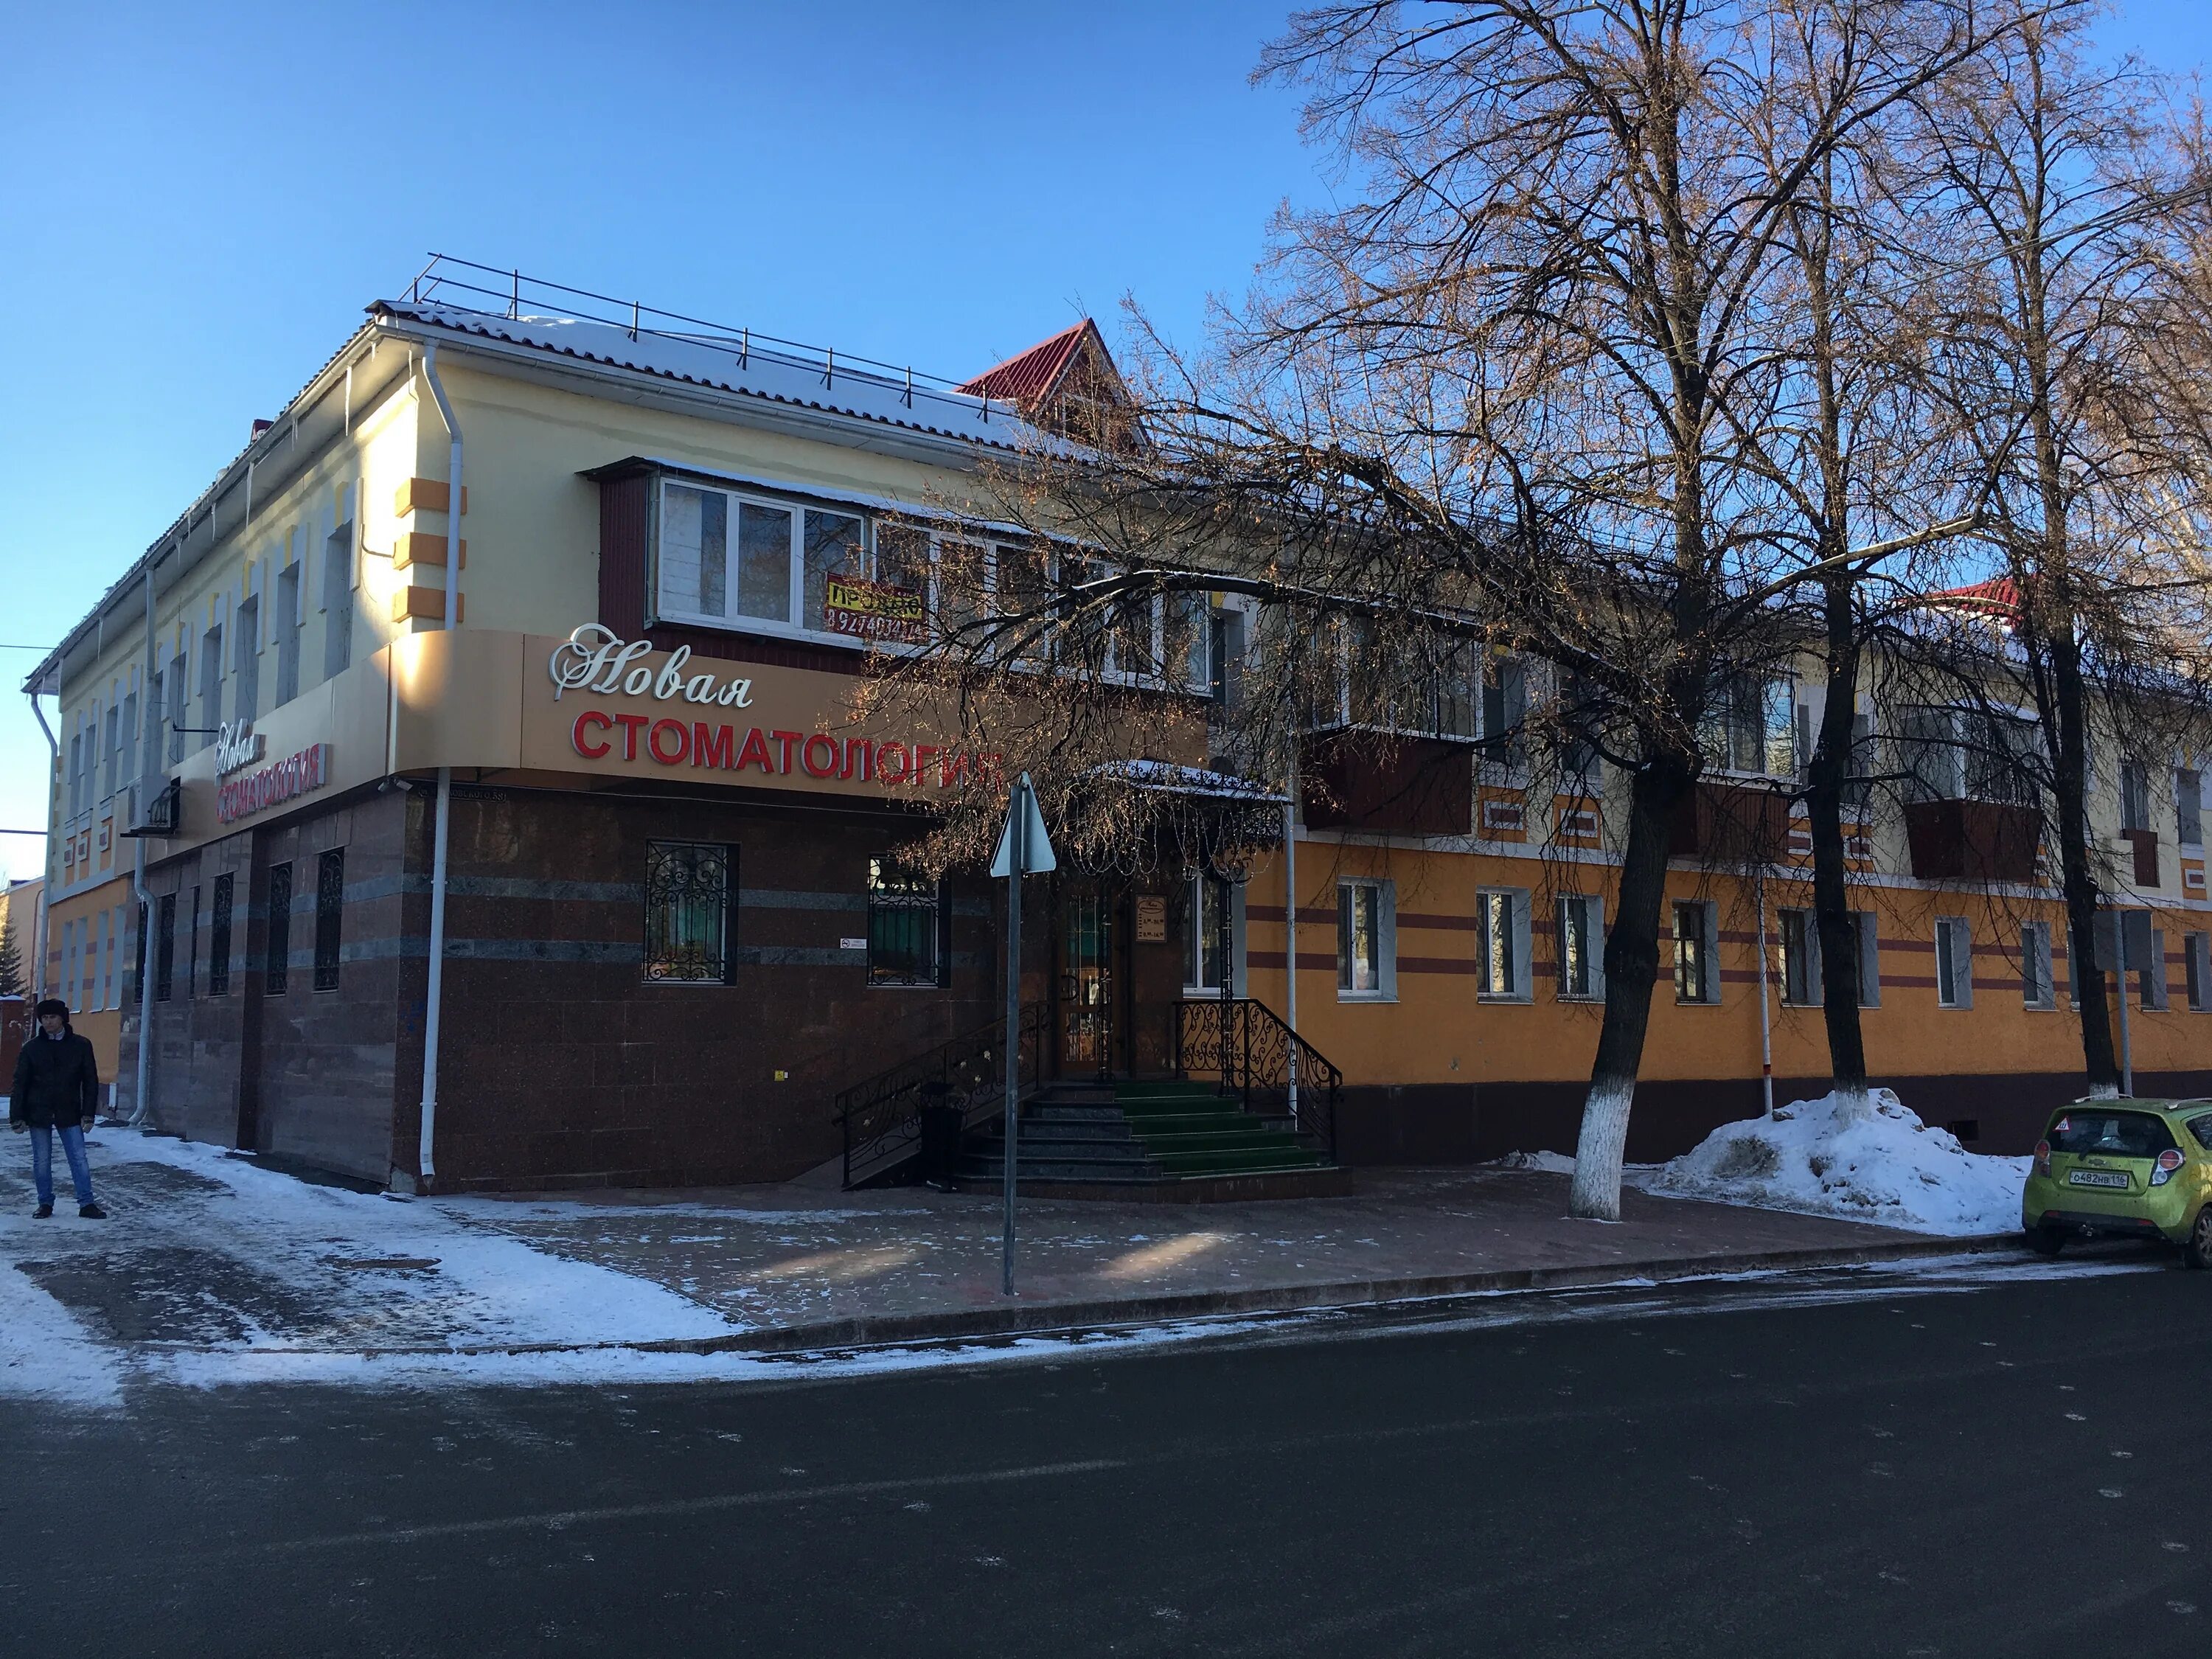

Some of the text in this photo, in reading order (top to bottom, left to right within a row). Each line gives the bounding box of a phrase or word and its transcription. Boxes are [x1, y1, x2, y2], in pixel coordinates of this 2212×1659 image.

[549, 623, 753, 708] Новая
[215, 718, 260, 782] Новая
[571, 711, 1004, 794] СТОМАТОЛОГИЯ
